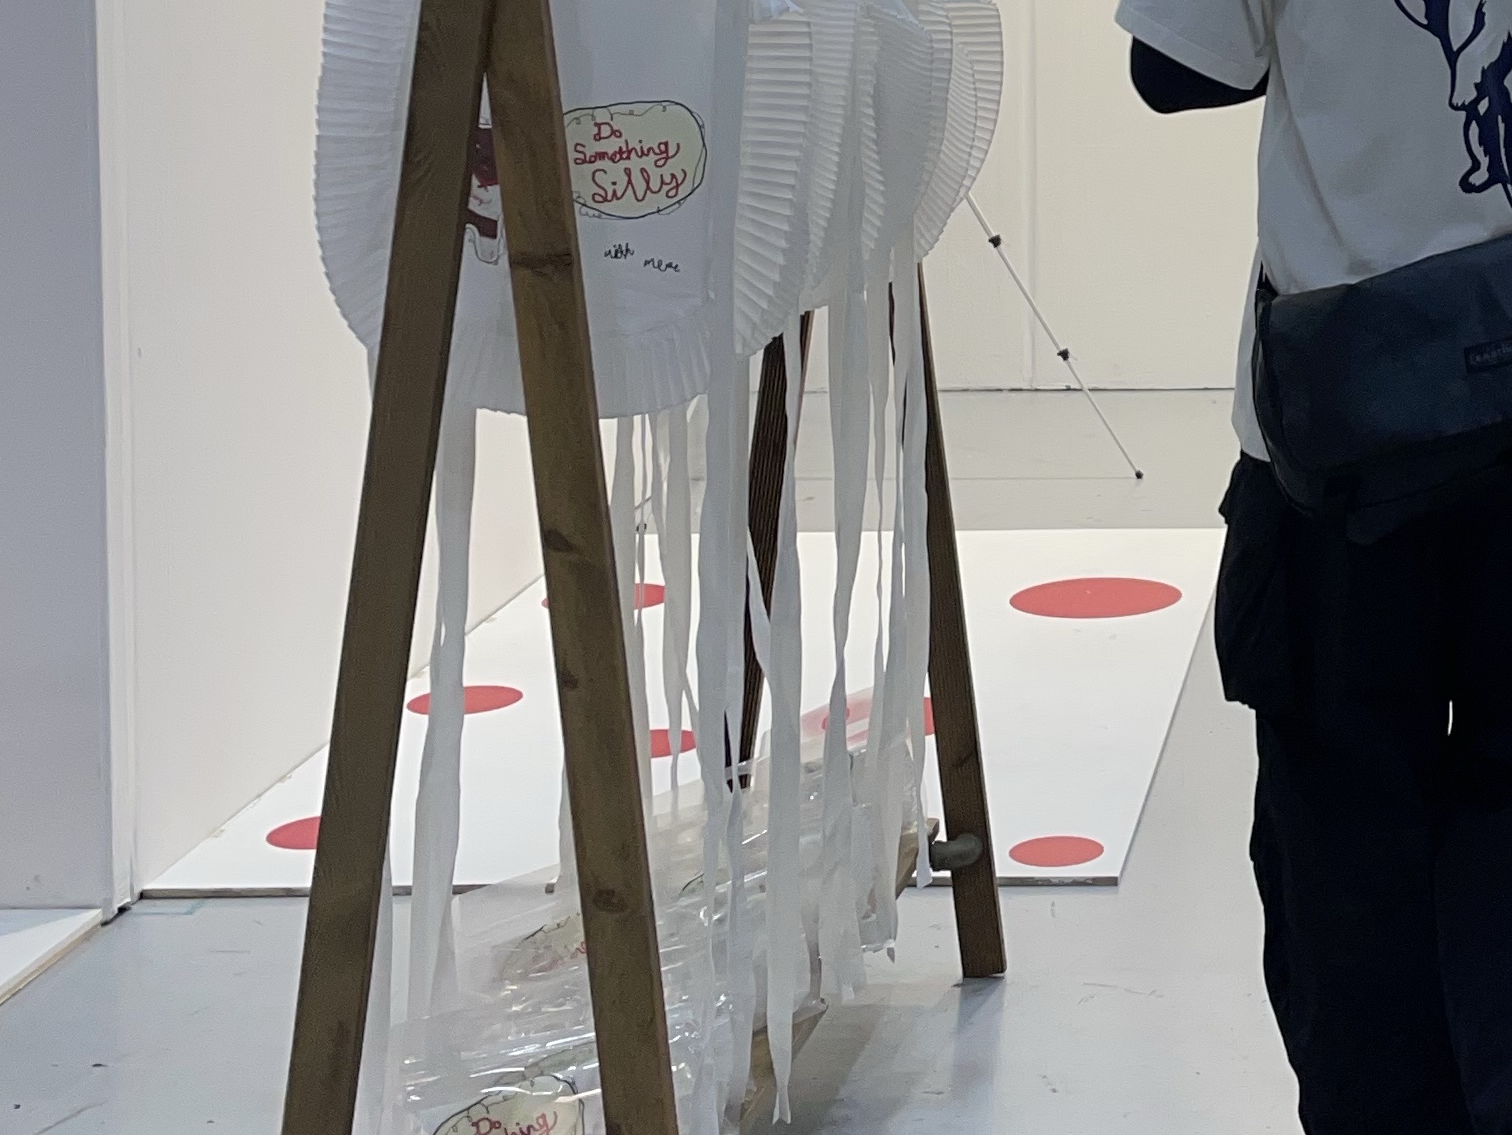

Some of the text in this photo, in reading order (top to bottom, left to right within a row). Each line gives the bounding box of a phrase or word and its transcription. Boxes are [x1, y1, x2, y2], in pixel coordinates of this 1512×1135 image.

[592, 120, 623, 143] Do
[573, 138, 681, 168] Something
[591, 167, 687, 204] Silly
